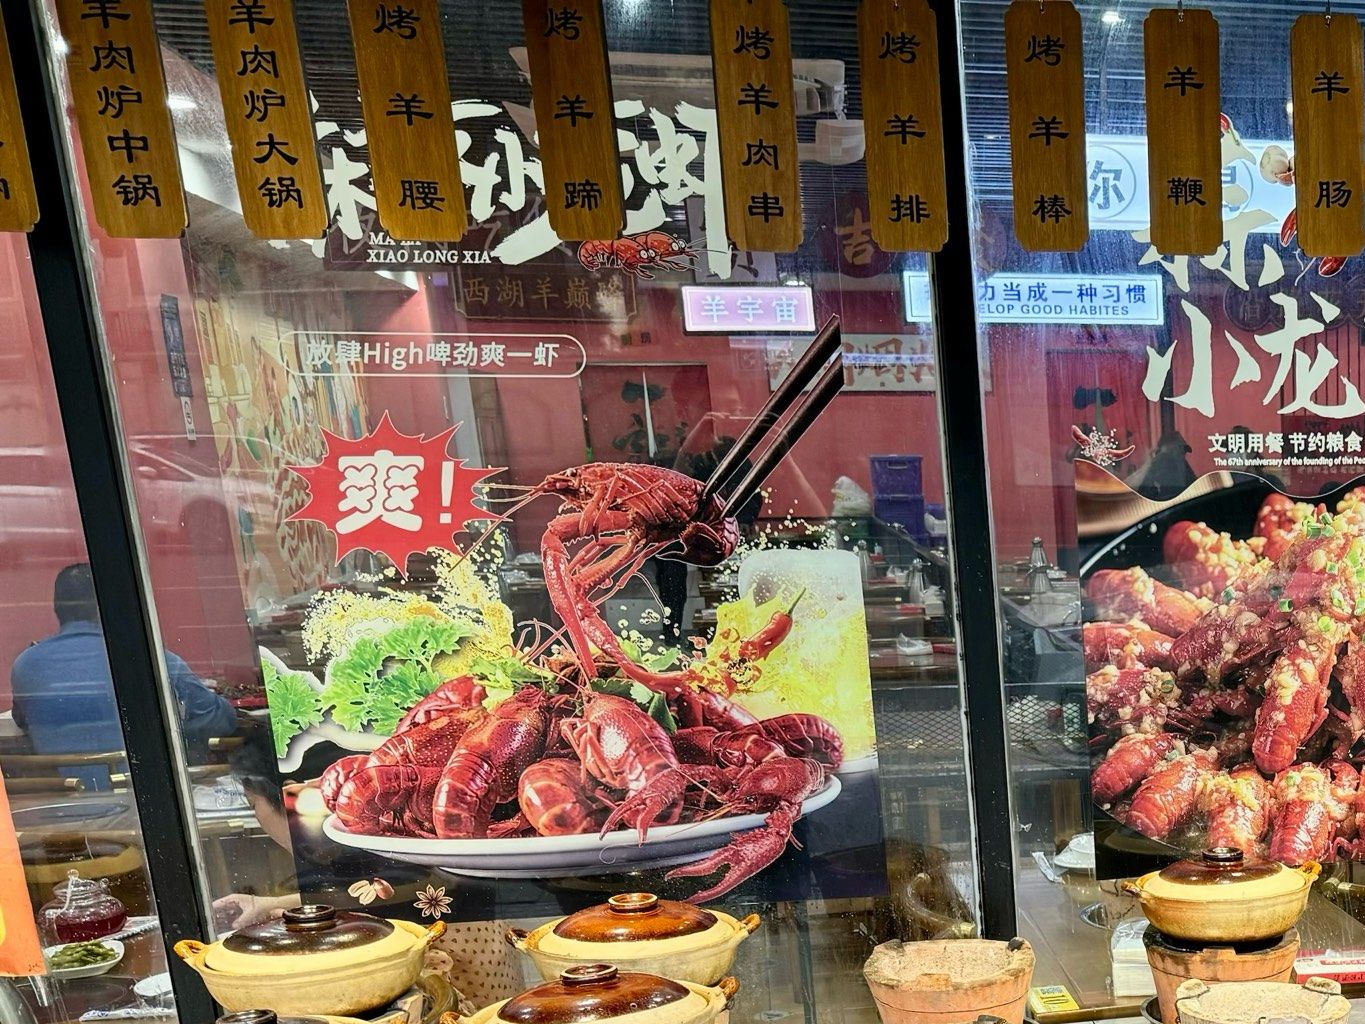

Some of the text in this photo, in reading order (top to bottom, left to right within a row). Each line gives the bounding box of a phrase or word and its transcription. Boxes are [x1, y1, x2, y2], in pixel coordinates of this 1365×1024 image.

[81, 0, 161, 207] 羊肉炉中锅
[228, 0, 304, 209] 羊肉炉大锅
[373, 3, 446, 212] 烤羊腰
[544, 7, 602, 211] 烤羊蹄
[734, 24, 785, 224] 烤羊肉串
[878, 31, 932, 224] 烤羊排
[1025, 35, 1072, 224] 烤羊棒
[1164, 65, 1207, 207] 羊鞭
[1311, 71, 1353, 210] 羊肠
[367, 250, 492, 264] XIAO LONG XIA
[701, 296, 798, 324] 羊宇宙
[1020, 304, 1063, 315] GOOD
[1069, 305, 1130, 316] HABITES
[306, 340, 560, 370] 放肆High啤劲爽一虾
[1208, 431, 1284, 453] 文明用餐
[1288, 431, 1363, 452] 节约粮食
[1214, 457, 1227, 466] The
[1228, 457, 1243, 466] 67th
[1245, 457, 1282, 467] anniversary
[1291, 456, 1303, 466] the
[1304, 456, 1333, 467] founding
[1342, 456, 1353, 466] the
